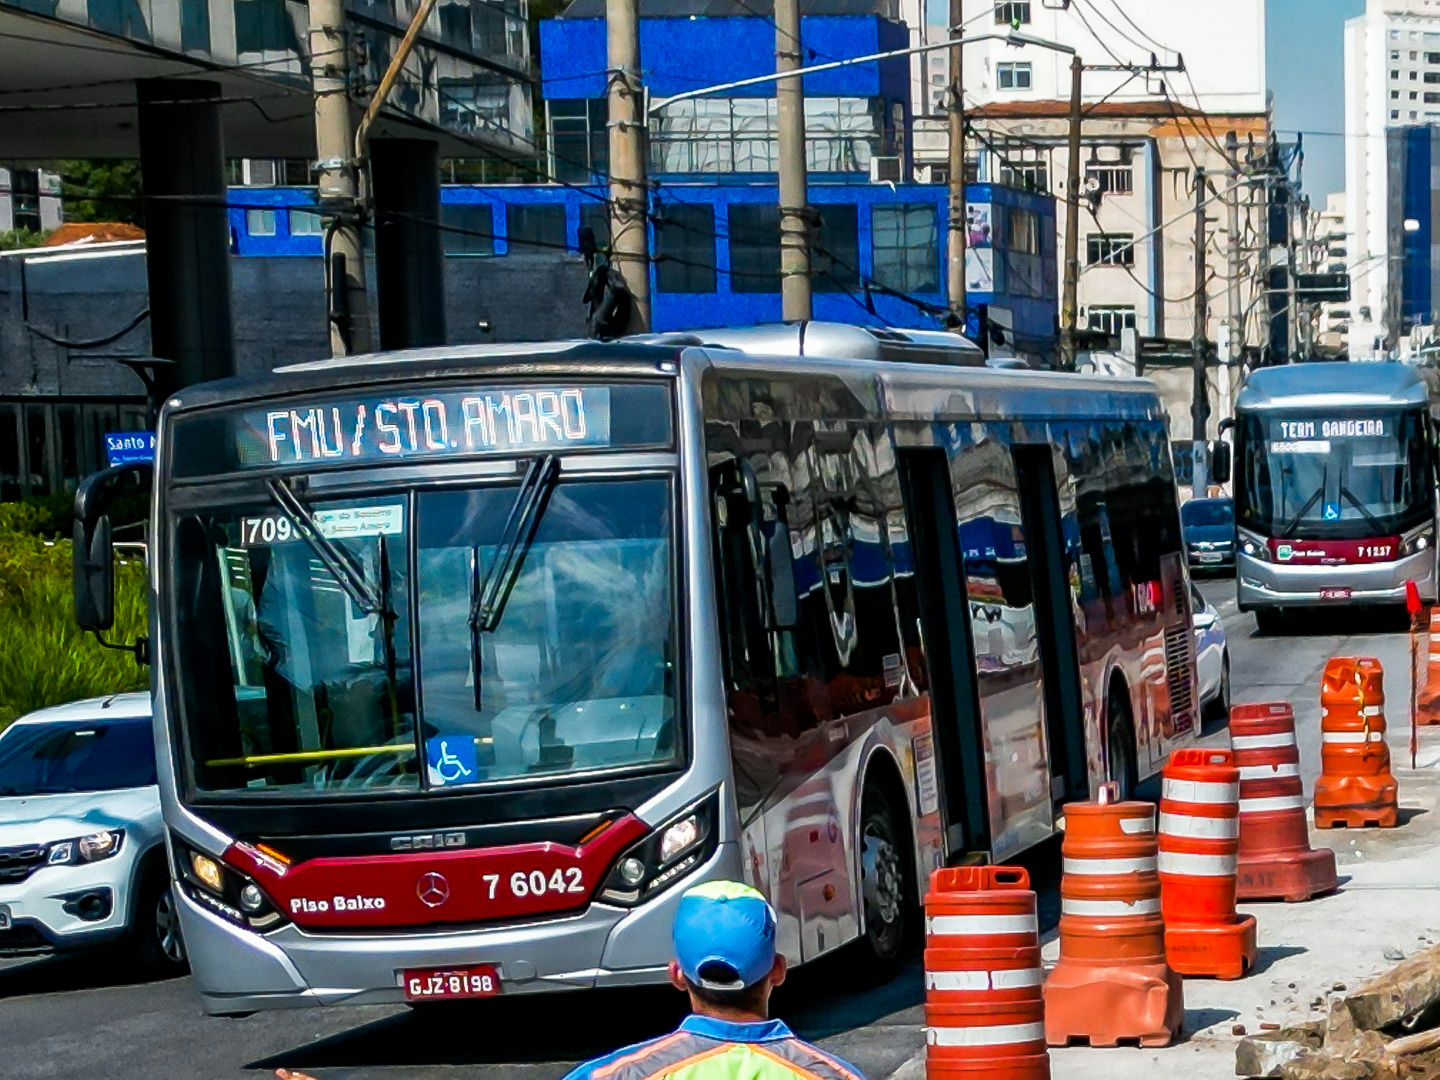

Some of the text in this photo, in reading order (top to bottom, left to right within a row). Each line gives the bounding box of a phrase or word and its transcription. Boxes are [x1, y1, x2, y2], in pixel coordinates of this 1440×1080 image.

[107, 436, 145, 450] Santo
[482, 866, 586, 900] 7 6042
[290, 895, 386, 914] Piso Baixo
